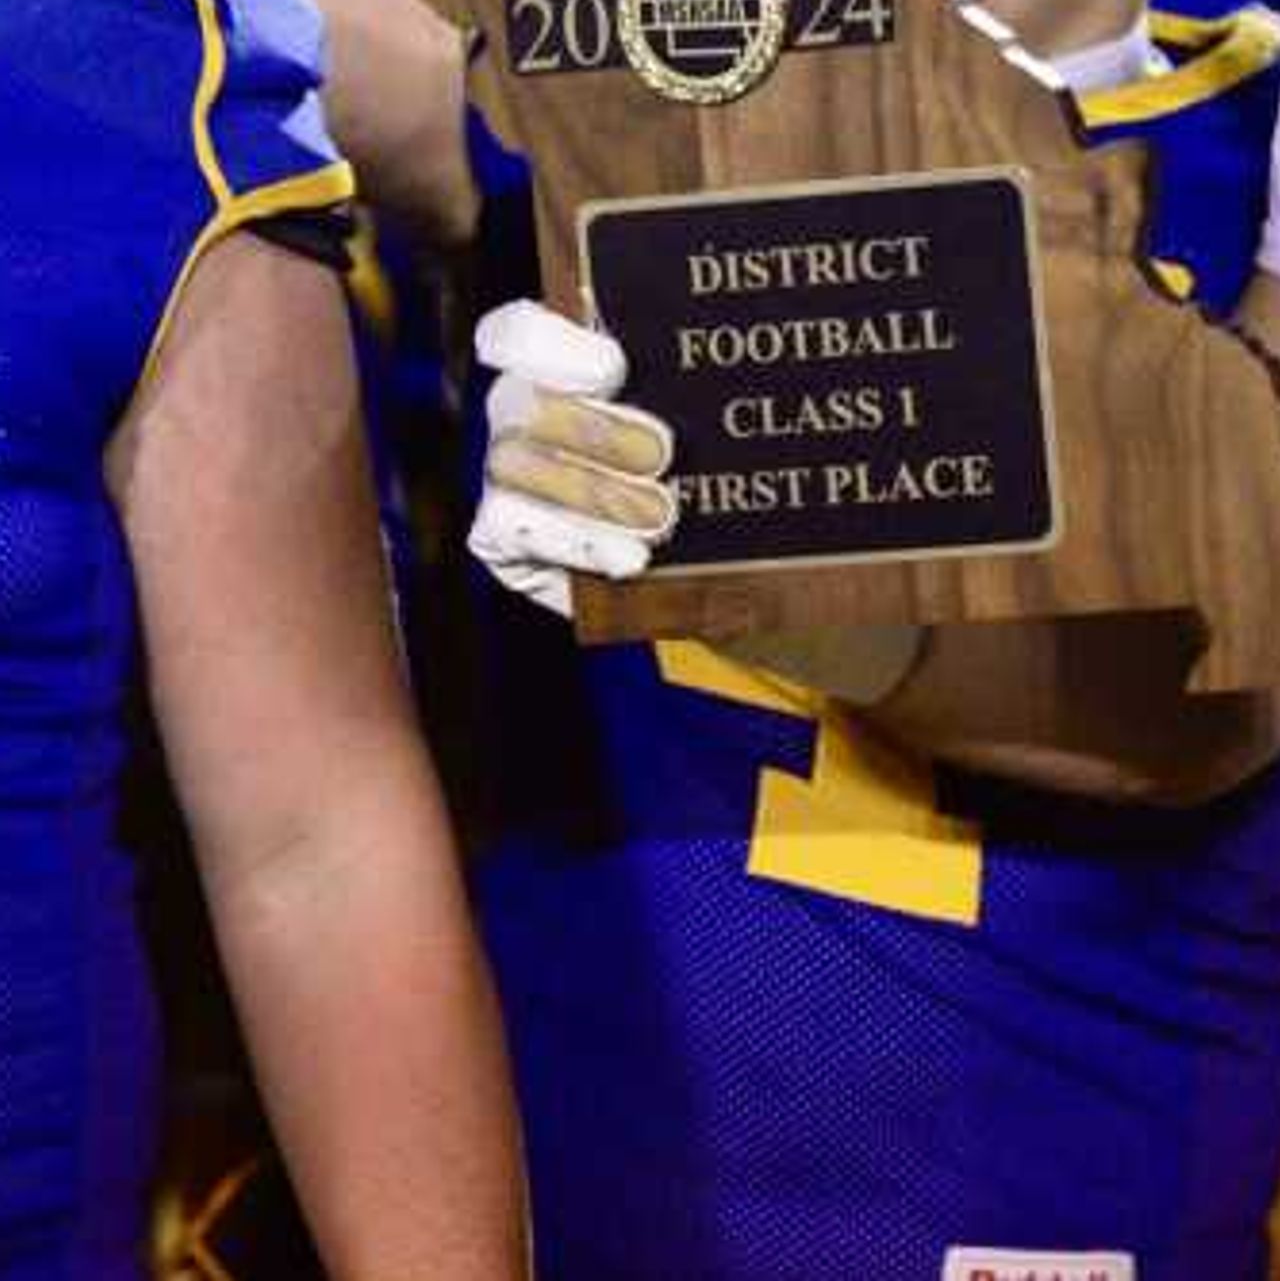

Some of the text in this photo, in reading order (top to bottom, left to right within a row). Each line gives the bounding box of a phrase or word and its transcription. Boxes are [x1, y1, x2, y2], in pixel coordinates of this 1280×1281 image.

[688, 237, 927, 296] DISTRICT
[676, 310, 956, 370] FOOTBALL
[722, 387, 883, 439] CLASS
[671, 455, 994, 516] FIRST PLACE
